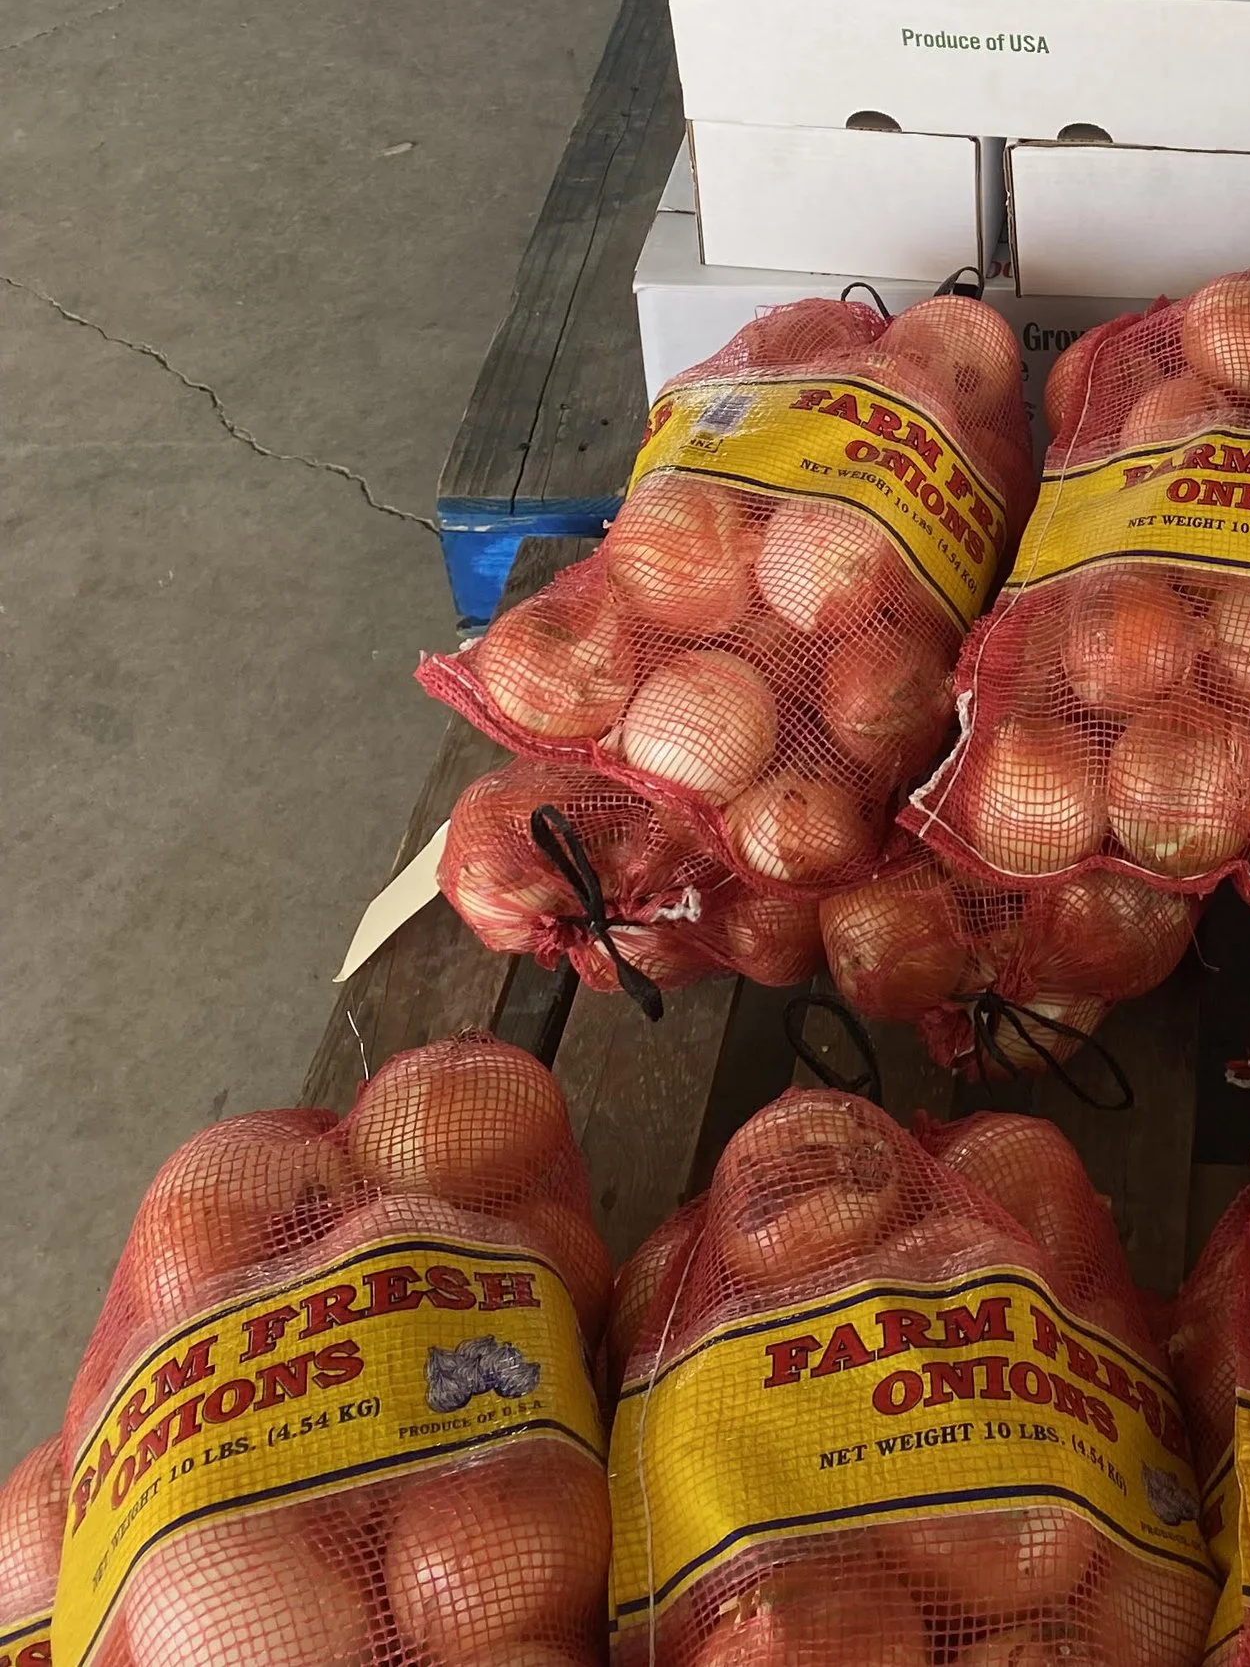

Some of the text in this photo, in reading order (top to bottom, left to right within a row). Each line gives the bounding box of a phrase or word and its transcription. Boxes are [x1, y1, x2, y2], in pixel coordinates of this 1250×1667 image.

[901, 28, 1050, 54] Produce of USA
[790, 388, 944, 474] FARM
[800, 457, 910, 514] NET WEIGHT 10
[845, 439, 986, 566] ONIONS
[1128, 513, 1250, 535] NET WEIGHT 10
[763, 1296, 1015, 1390] FARM
[72, 1265, 541, 1535] FARM FRESH
[111, 1339, 365, 1510] ONIONS
[168, 1396, 382, 1484] 10 LBS. (4.54 KG)
[398, 1416, 473, 1439] PRODUCE
[476, 1410, 498, 1425] OF
[872, 1356, 1119, 1444] ONIONS
[818, 1421, 1129, 1497] NET WEIGHT 10 LBS. (4.54 KG)
